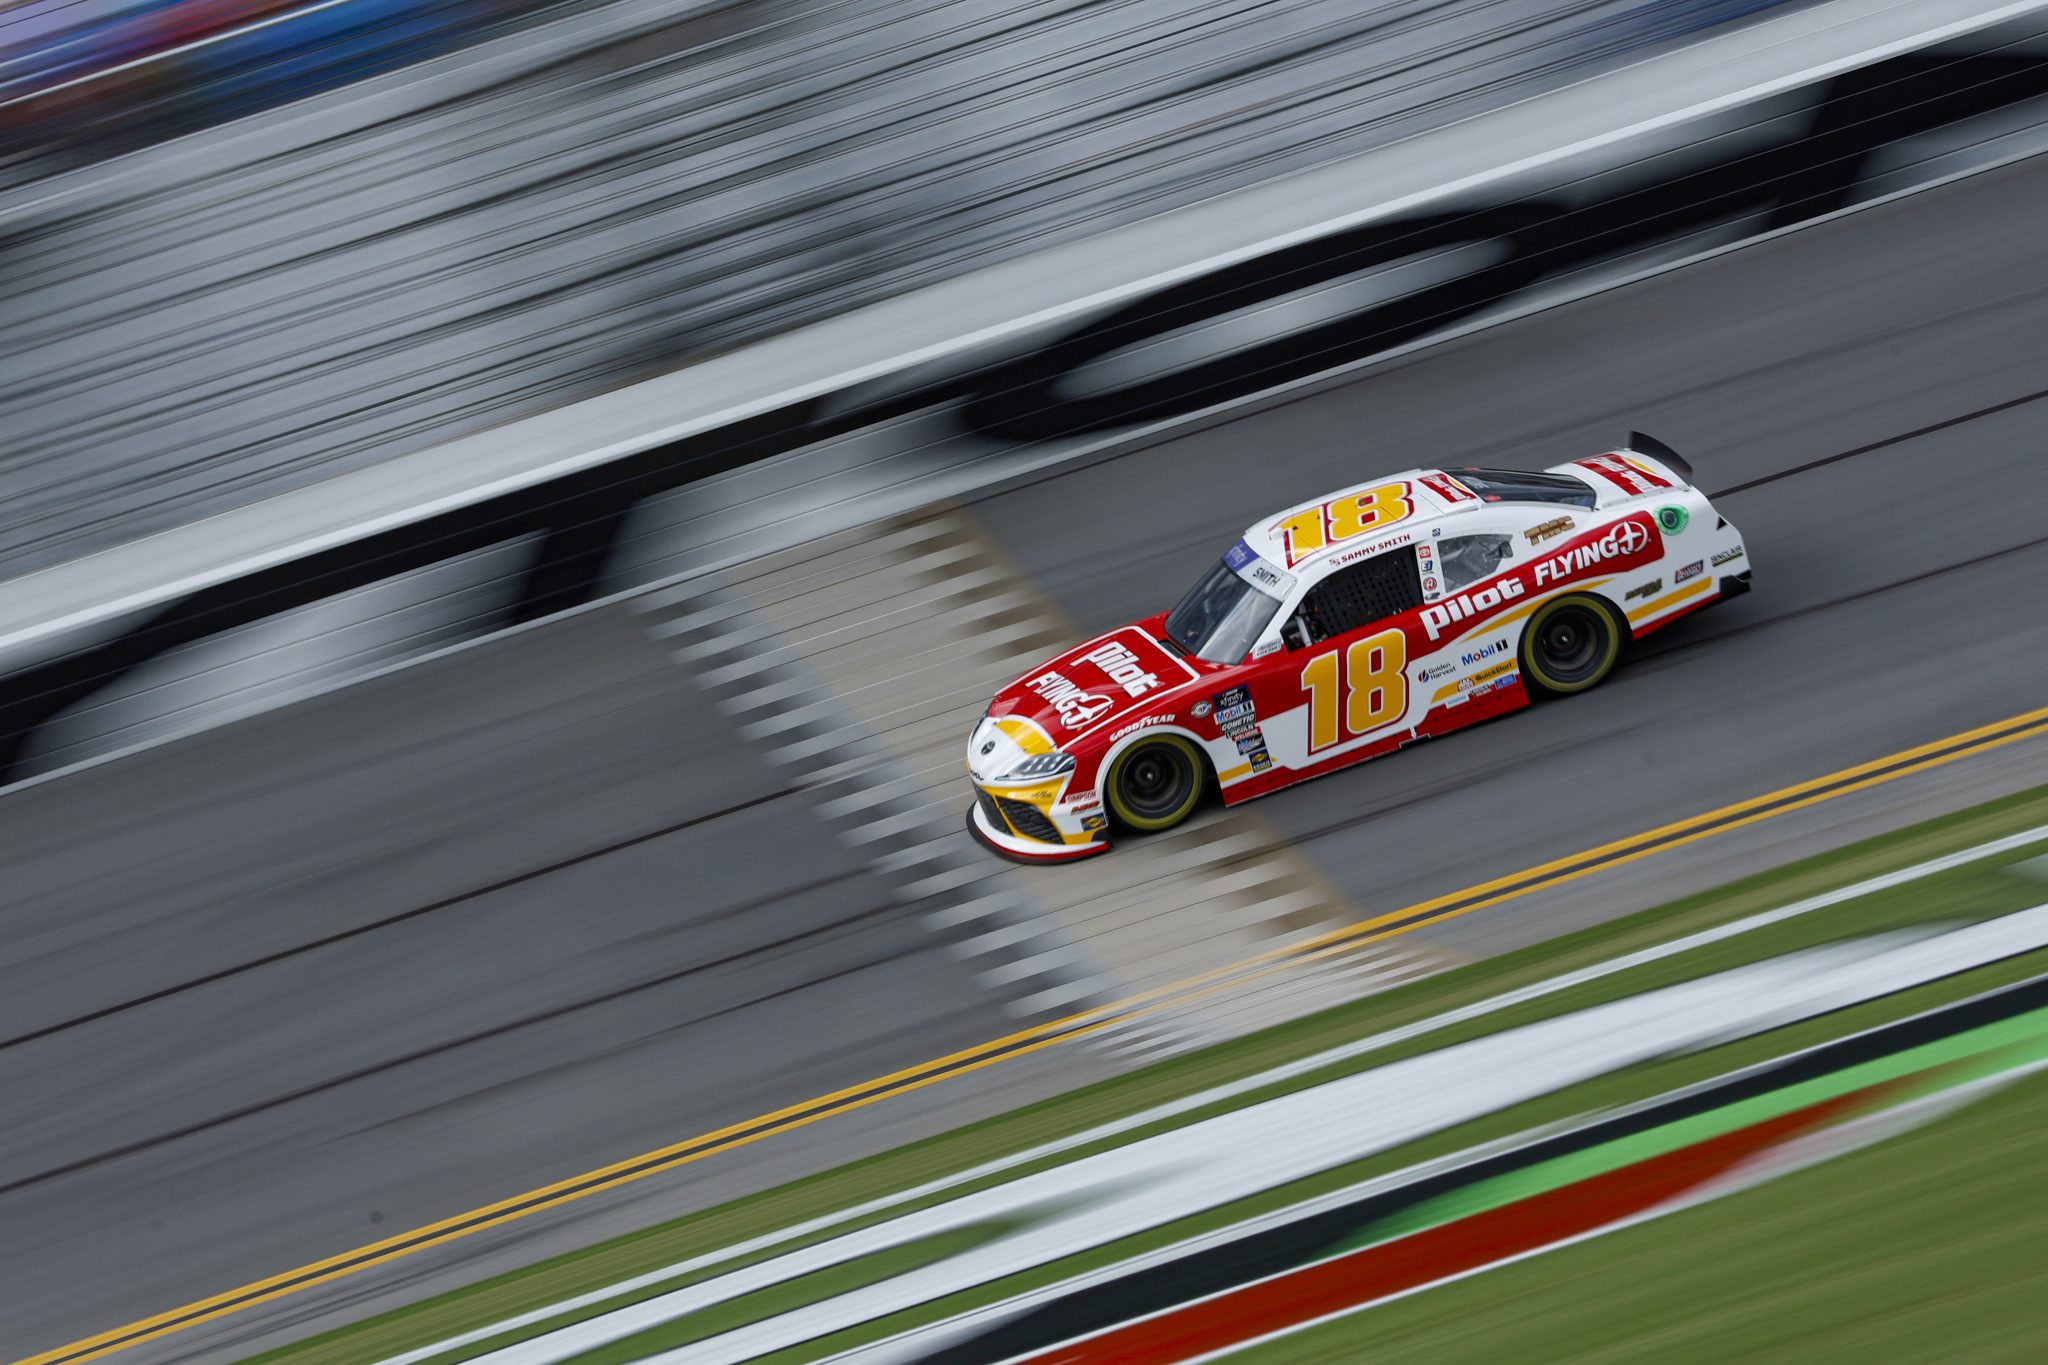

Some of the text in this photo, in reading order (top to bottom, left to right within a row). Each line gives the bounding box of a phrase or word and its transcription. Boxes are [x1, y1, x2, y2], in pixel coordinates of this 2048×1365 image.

[1275, 481, 1413, 568] 18
[1524, 515, 1576, 546] TMC
[1341, 545, 1376, 562] SAMMY
[1378, 534, 1411, 551] SMITH
[1710, 545, 1743, 563] SINCLAIR
[1252, 567, 1280, 587] SMITH
[1461, 644, 1495, 666] Mobil
[1428, 662, 1451, 674] Golden
[1430, 666, 1456, 680] Harvest
[1301, 628, 1407, 753] 18
[1216, 705, 1241, 721] Mobil
[1109, 714, 1176, 742] GOODYEAR
